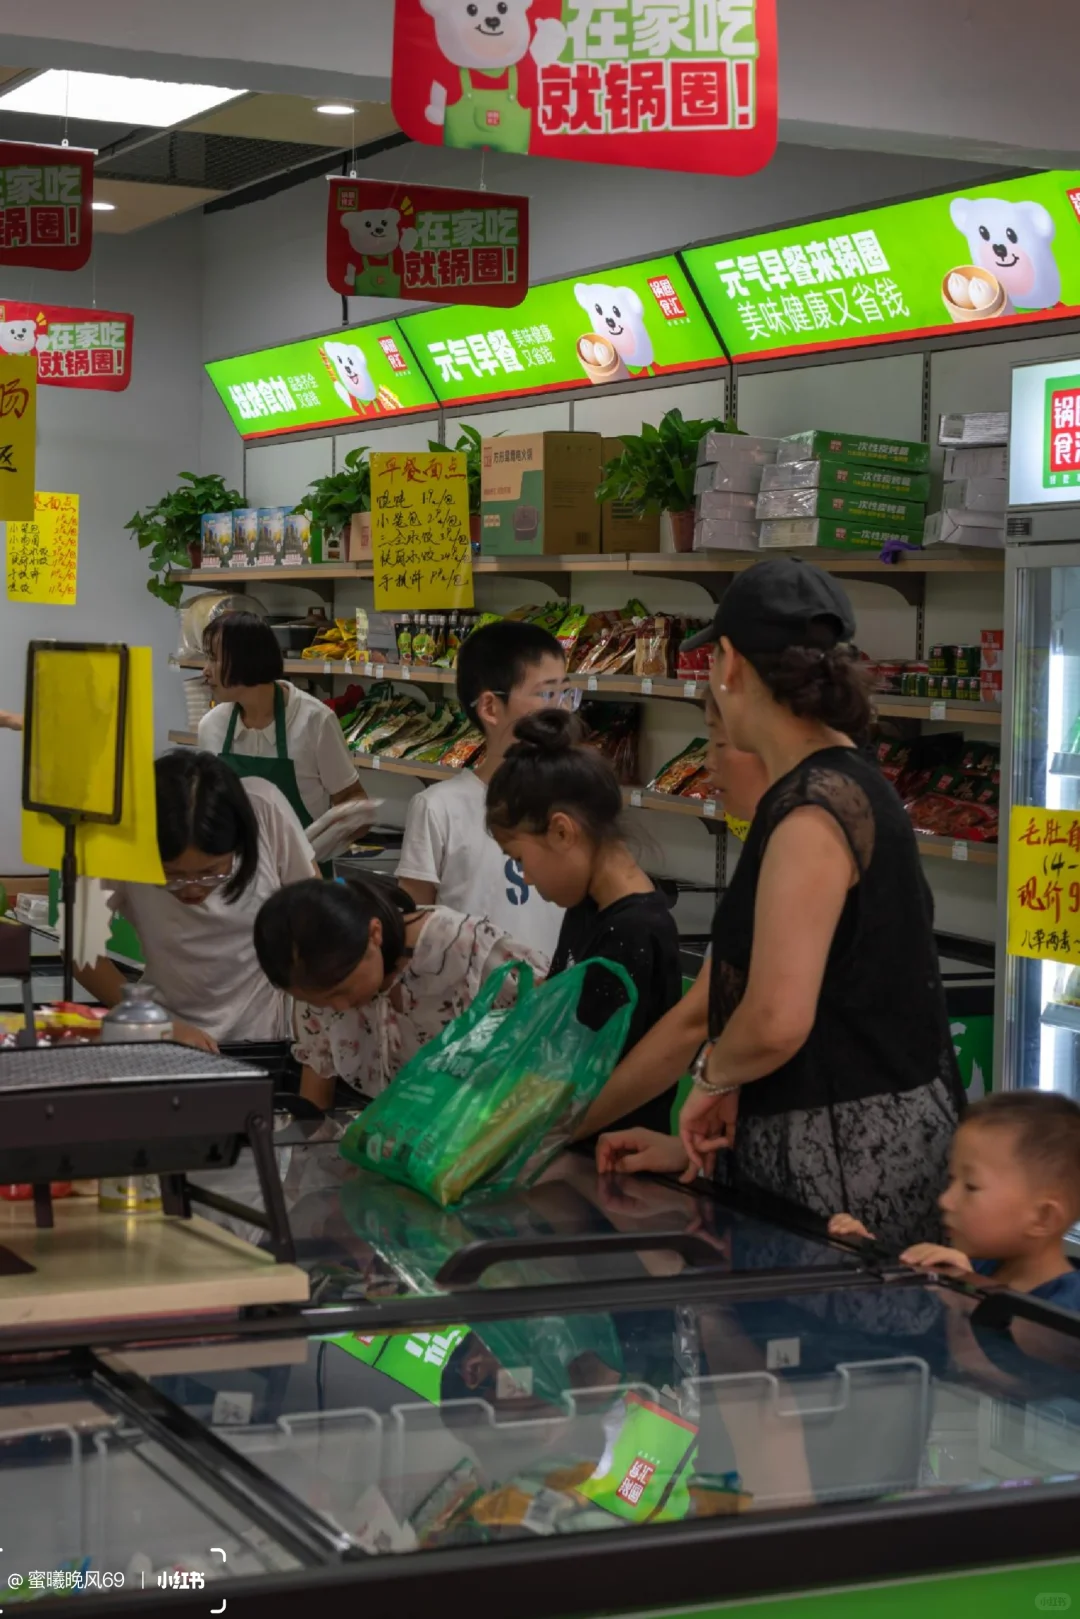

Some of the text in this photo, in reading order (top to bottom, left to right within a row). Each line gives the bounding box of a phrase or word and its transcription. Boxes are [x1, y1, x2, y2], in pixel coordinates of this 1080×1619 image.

[566, 0, 757, 59] 在家吃
[538, 59, 754, 135] 就锅圈!
[0, 167, 81, 205] 家吃
[419, 209, 518, 247] 在家吃
[404, 246, 516, 288] 就锅圈!
[715, 229, 891, 299] 元气早餐来锅圈
[737, 277, 910, 340] 美味健康又省钱
[49, 321, 126, 350] 在家吃
[511, 323, 556, 348] 美味健康
[38, 348, 123, 377] 就锅圈!
[427, 329, 525, 382] 元气早餐
[521, 344, 556, 367] 又省钱
[1054, 395, 1080, 429] 锅
